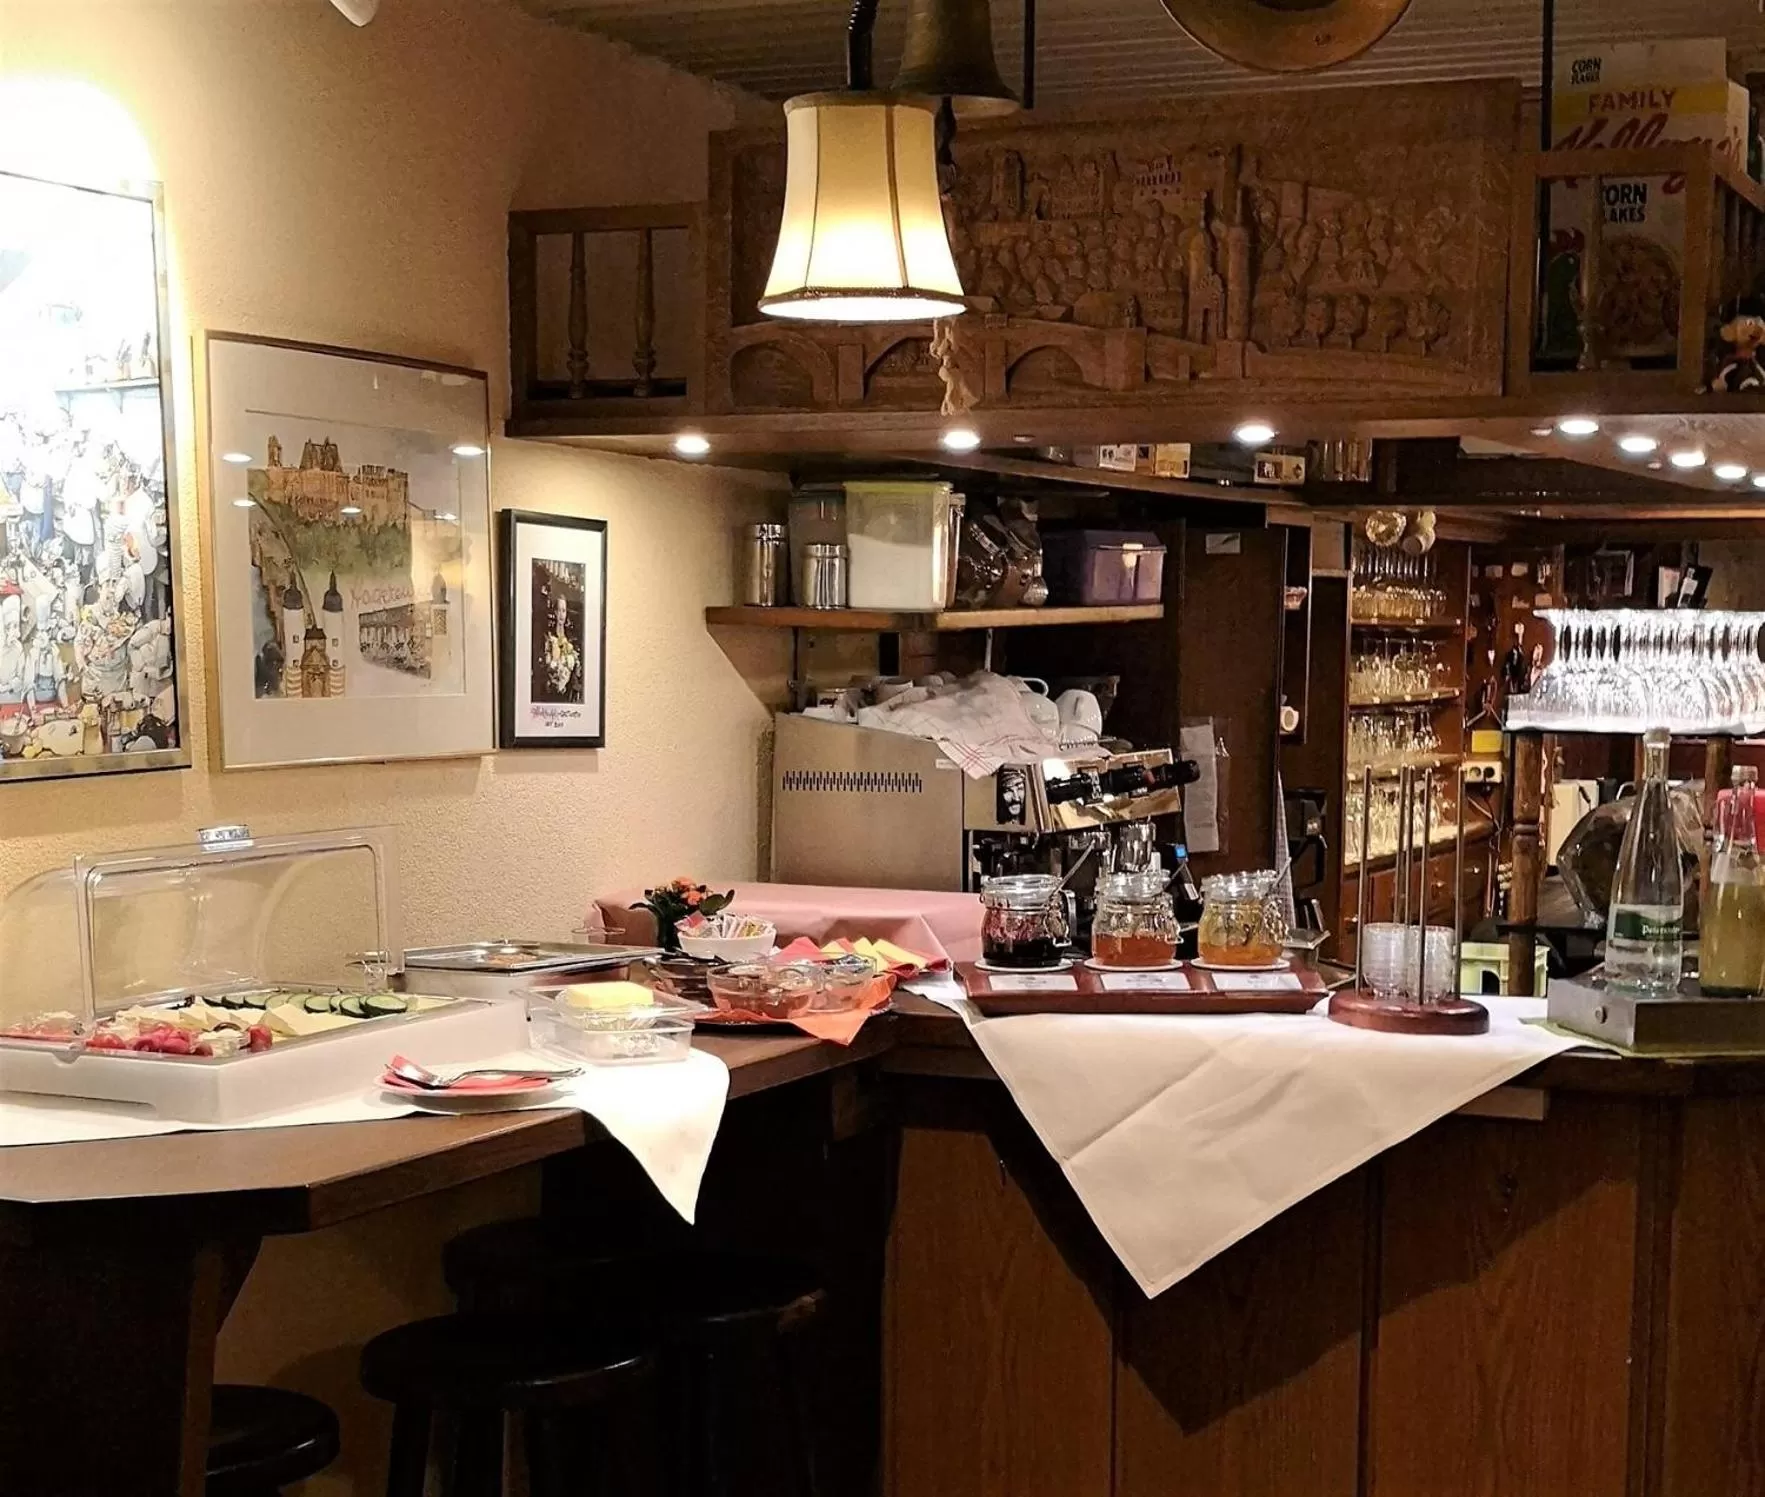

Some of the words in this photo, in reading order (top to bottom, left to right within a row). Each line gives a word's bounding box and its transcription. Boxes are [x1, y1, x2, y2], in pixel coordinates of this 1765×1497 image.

[1571, 57, 1602, 73] CORN
[1588, 90, 1677, 114] FAMILY
[1602, 204, 1646, 224] AKES
